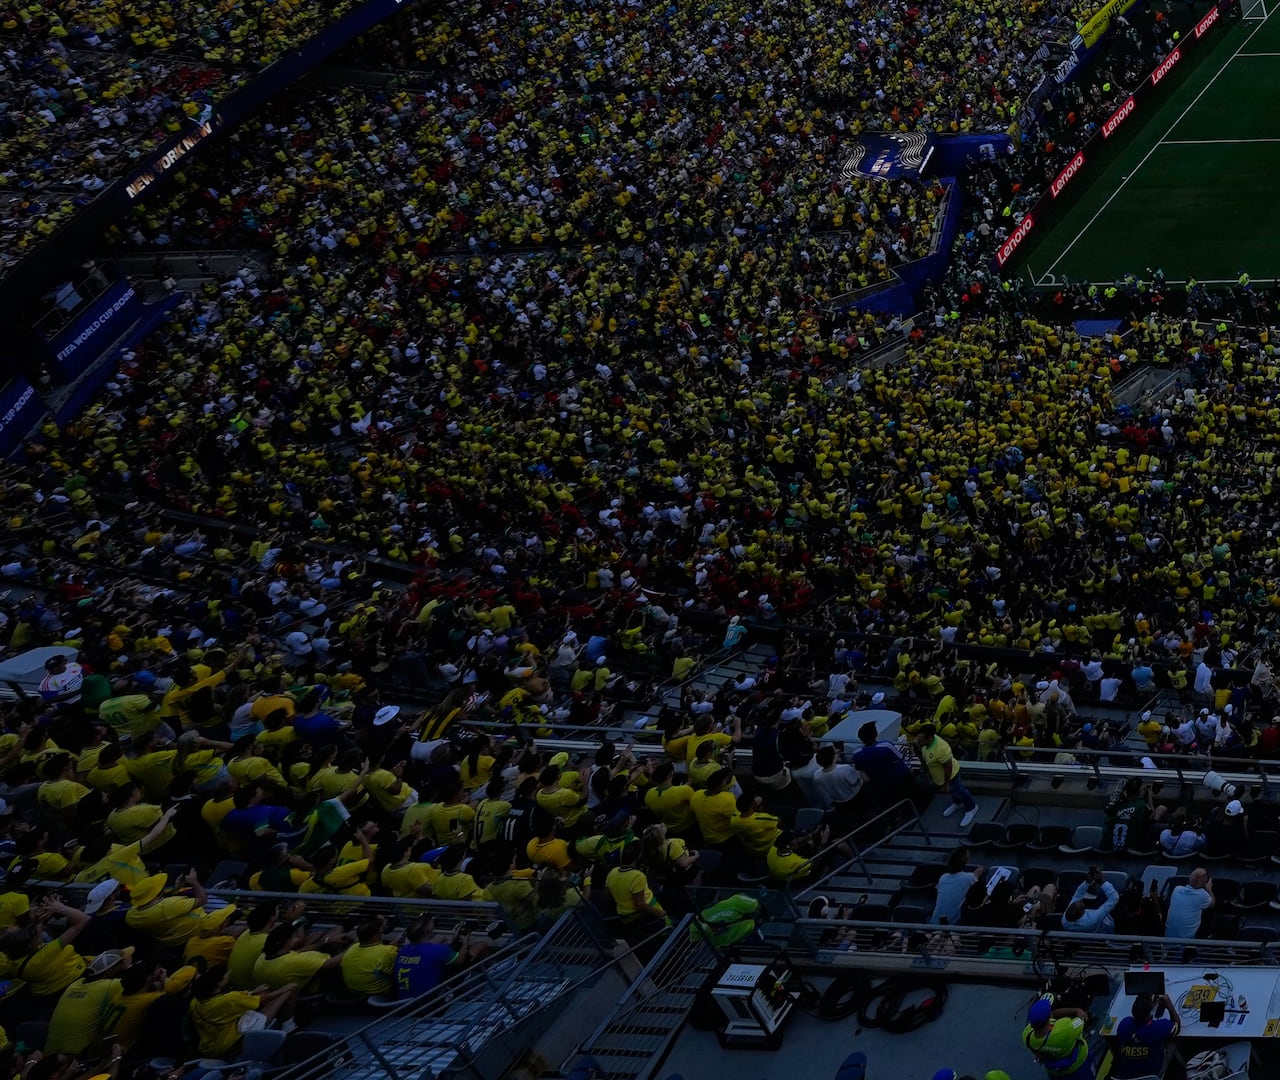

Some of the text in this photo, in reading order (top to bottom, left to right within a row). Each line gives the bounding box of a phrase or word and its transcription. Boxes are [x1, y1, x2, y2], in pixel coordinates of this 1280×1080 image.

[1151, 50, 1181, 87] Lenovo
[1101, 97, 1136, 140] Lenovo
[1050, 153, 1084, 199] Lenovo
[997, 214, 1034, 266] Lenovo
[56, 287, 136, 362] FIFA WORLD CUP 2026
[14, 385, 35, 413] 2026
[1267, 1022, 1274, 1032] B
[1121, 1045, 1149, 1057] PRESS
